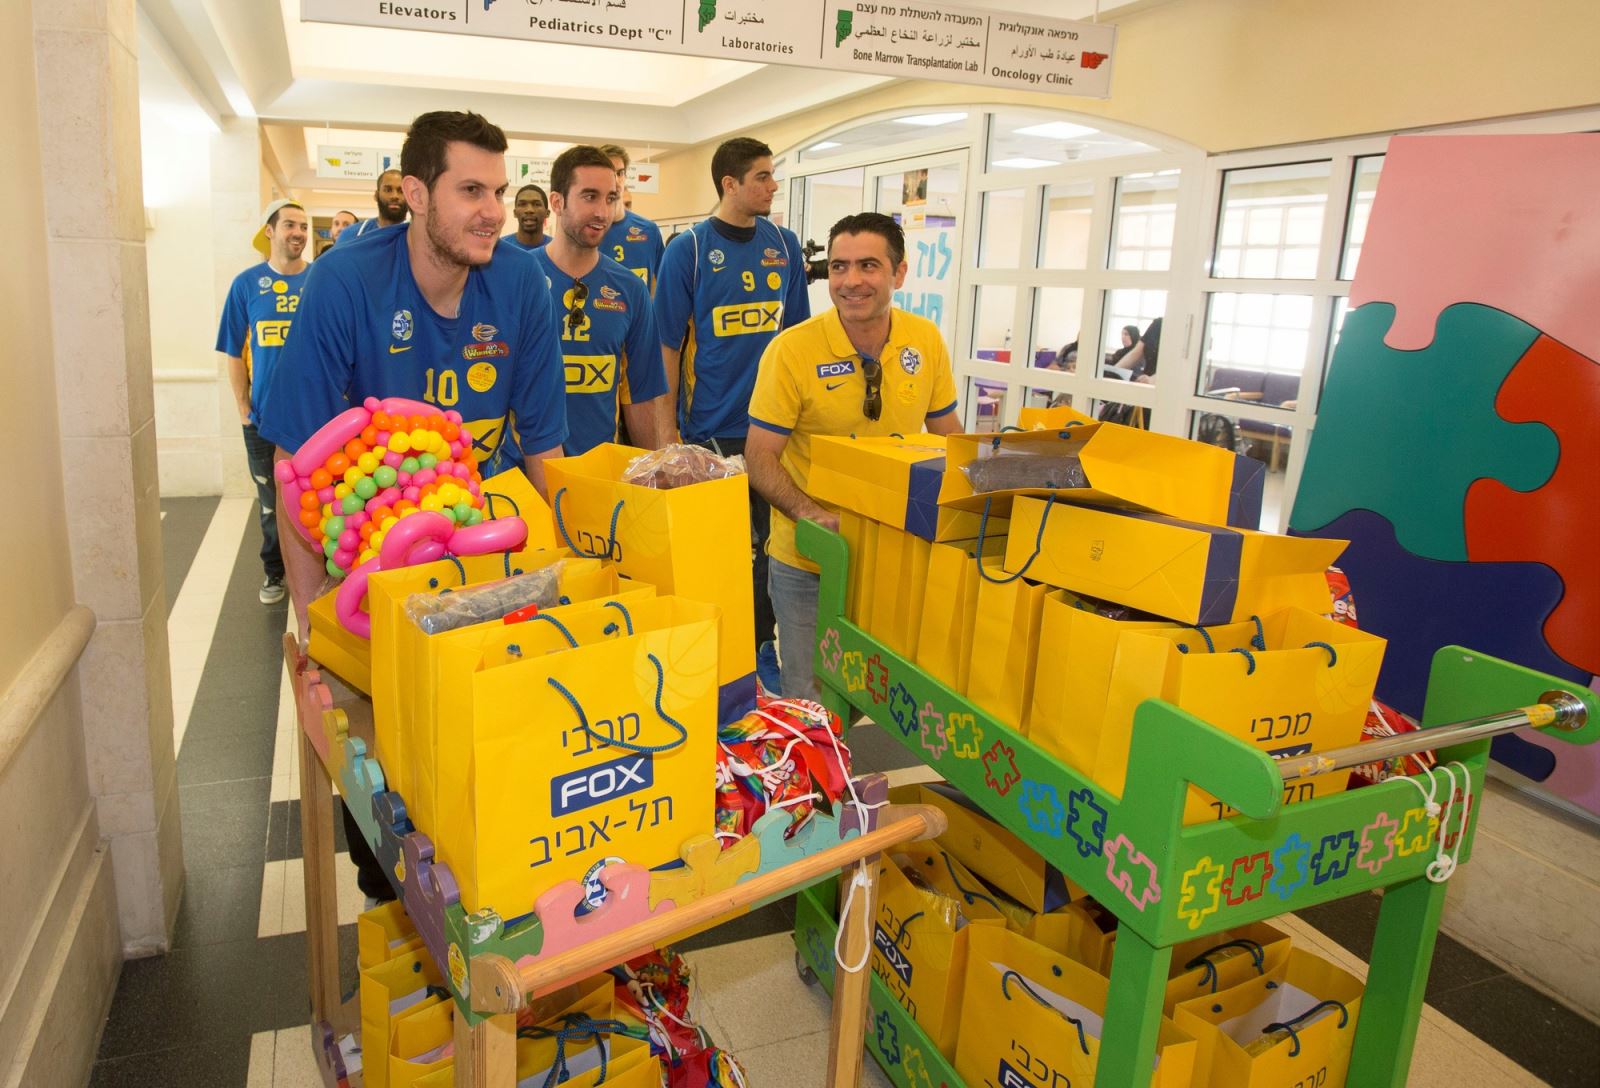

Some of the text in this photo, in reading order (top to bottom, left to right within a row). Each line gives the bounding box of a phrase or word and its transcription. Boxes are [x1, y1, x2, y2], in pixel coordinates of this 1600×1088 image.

[379, 2, 457, 21] Elevators
[724, 10, 765, 25] مختبرات
[856, 2, 983, 26] המעבדה להשתלת מח עצם
[529, 16, 672, 41] Pediatrics Dept "C"
[855, 24, 887, 39] العظمي
[890, 28, 918, 43] النخاع
[998, 21, 1079, 41] מרפאה אונקולוגית
[722, 36, 794, 54] Laboratories
[956, 36, 981, 49] مختبر
[853, 48, 979, 72] Bone Marrow Transplantation Lab
[1040, 48, 1054, 61] طب
[1056, 50, 1076, 64] عيادة
[991, 66, 1075, 86] Oncology Clinic
[613, 245, 625, 262] 3
[742, 270, 756, 292] 9
[275, 294, 300, 312] 22
[561, 314, 591, 341] 12
[722, 307, 781, 330] FOX
[565, 362, 611, 387] OX
[820, 361, 852, 376] FOX
[423, 368, 459, 406] 10
[561, 712, 641, 757] מכבי
[1250, 712, 1312, 742] מכבי
[560, 757, 646, 809] FOX
[529, 795, 673, 868] תל-אביב
[875, 929, 909, 981] FOX
